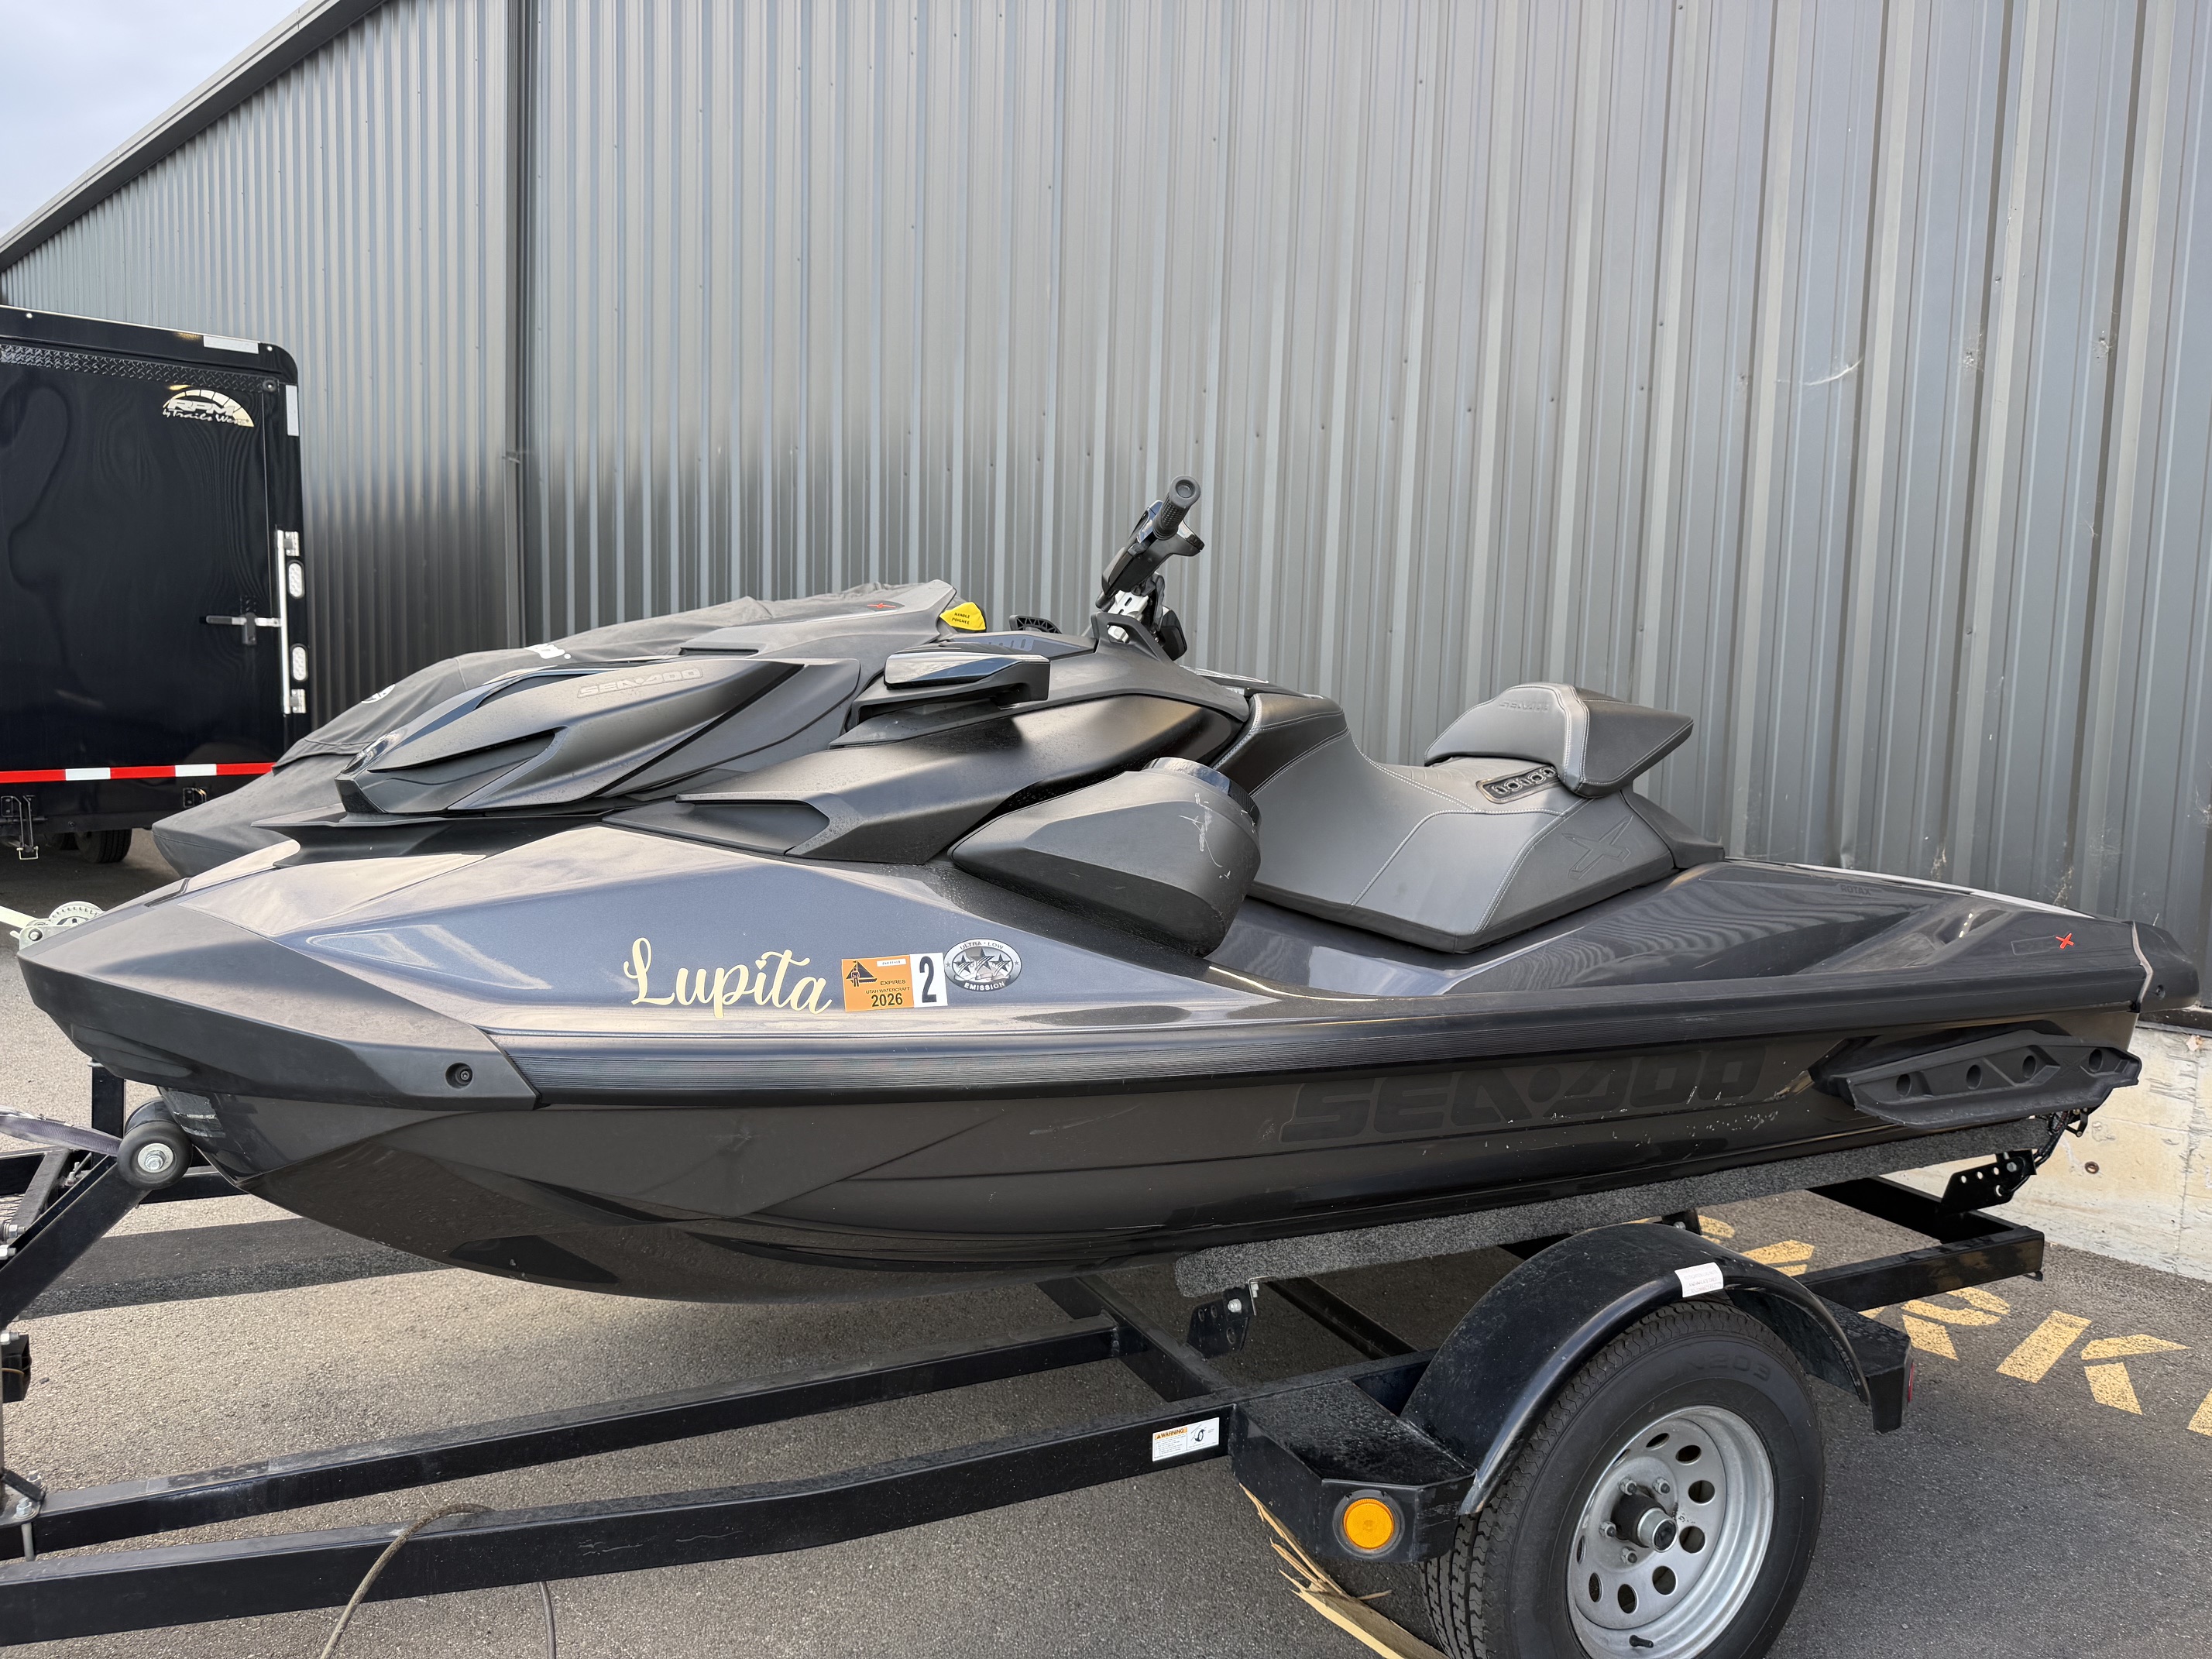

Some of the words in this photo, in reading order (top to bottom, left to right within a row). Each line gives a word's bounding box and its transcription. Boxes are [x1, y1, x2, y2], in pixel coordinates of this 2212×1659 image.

[167, 398, 235, 416] RPM
[162, 408, 170, 417] by
[168, 409, 213, 421] Trails
[1840, 884, 1871, 895] ROTAX
[960, 941, 982, 950] ULTRA
[623, 937, 833, 1018] Lupita
[919, 956, 937, 1003] 2
[963, 981, 1005, 991] EMISSION
[871, 992, 903, 1007] 2026
[1160, 1427, 1185, 1438] WARNING
